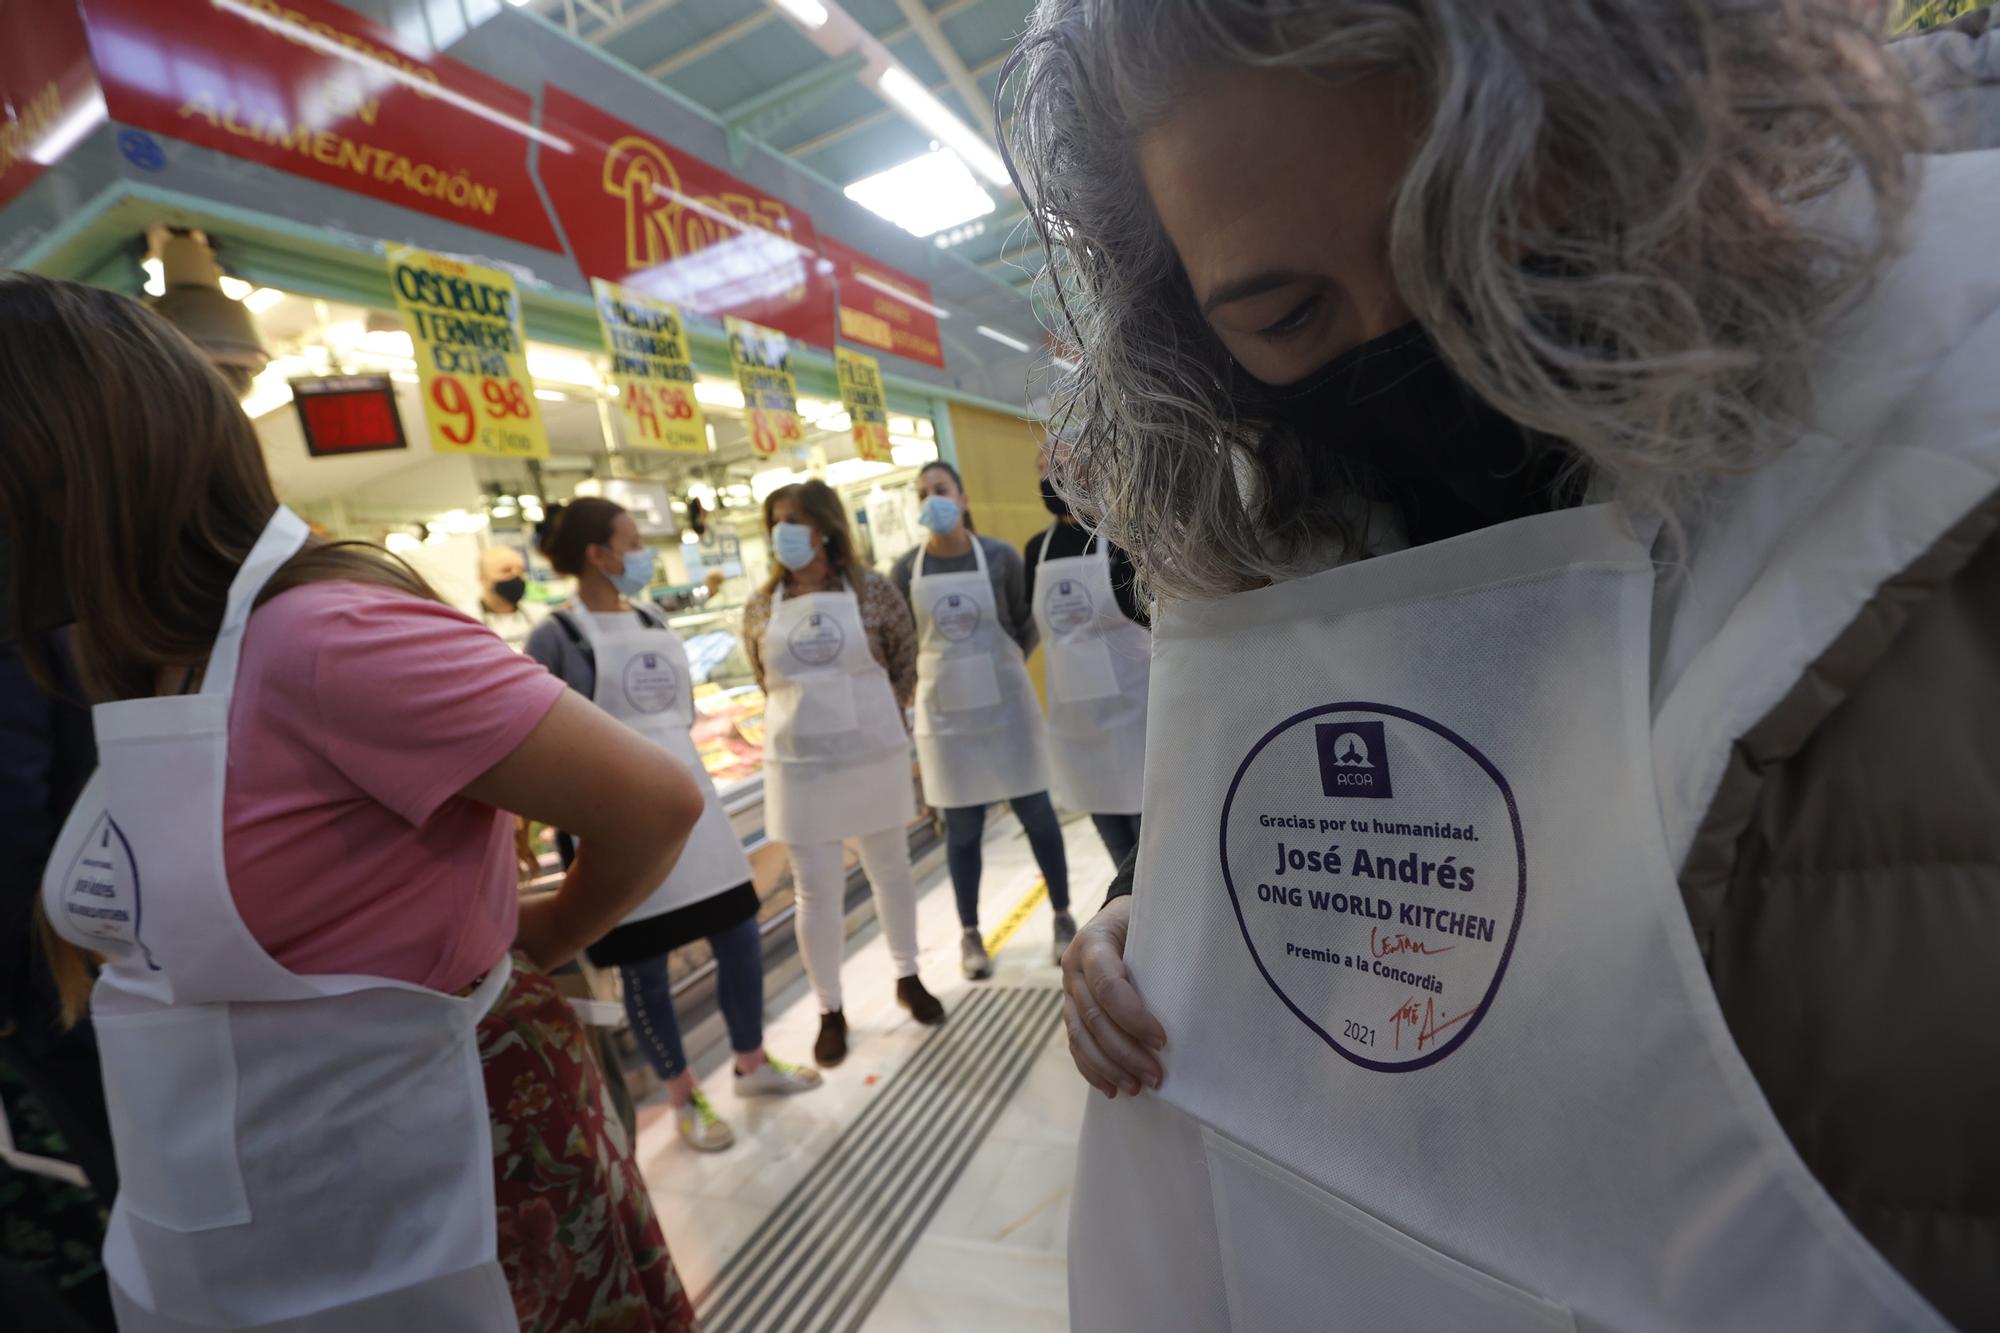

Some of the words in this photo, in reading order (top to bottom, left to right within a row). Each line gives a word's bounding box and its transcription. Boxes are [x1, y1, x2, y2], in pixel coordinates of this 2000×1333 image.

[177, 91, 498, 215] ALIMENTACIÓN
[431, 374, 476, 446] 9
[481, 376, 532, 421] 98
[1337, 773, 1373, 787] ACOA
[1259, 815, 1316, 830] Gracias
[1320, 819, 1346, 834] por
[1350, 820, 1369, 833] tu
[1372, 818, 1480, 842] humanidad.
[1275, 842, 1342, 876] José
[1351, 848, 1476, 892] Andrés
[1257, 884, 1302, 907] ONG
[1308, 890, 1393, 921] WORLD
[1399, 902, 1496, 943] KITCHEN
[1286, 942, 1341, 965] Premio
[1344, 956, 1354, 967] a
[1356, 955, 1369, 972] la
[1372, 960, 1444, 995] Concordia
[1343, 1019, 1376, 1048] 2021
